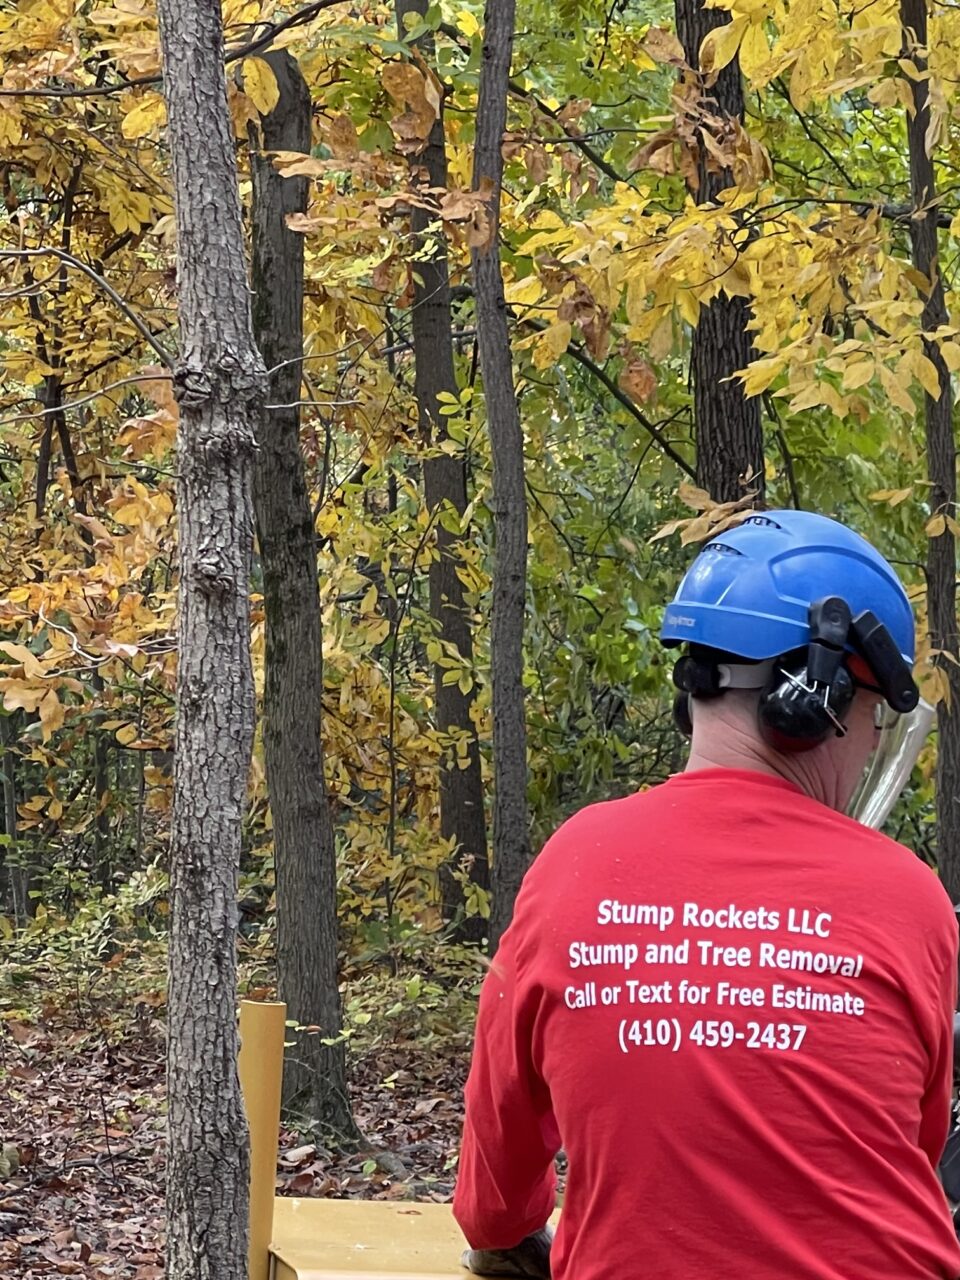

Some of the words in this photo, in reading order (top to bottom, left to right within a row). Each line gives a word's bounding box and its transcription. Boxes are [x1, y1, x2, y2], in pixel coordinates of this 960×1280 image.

[597, 900, 674, 931] Stump
[683, 903, 780, 931] Rockets
[787, 908, 832, 937] LLC
[569, 942, 639, 970] Stump
[644, 939, 690, 965] and
[697, 941, 751, 967] Tree
[759, 943, 864, 978] Removal
[564, 981, 597, 1009] Call
[600, 986, 622, 1005] or
[625, 981, 673, 1004] Text
[678, 980, 711, 1005] for
[717, 982, 765, 1007] Free
[772, 985, 865, 1015] Estimate
[618, 1019, 682, 1053] (410)
[689, 1021, 807, 1050] 459-2437
